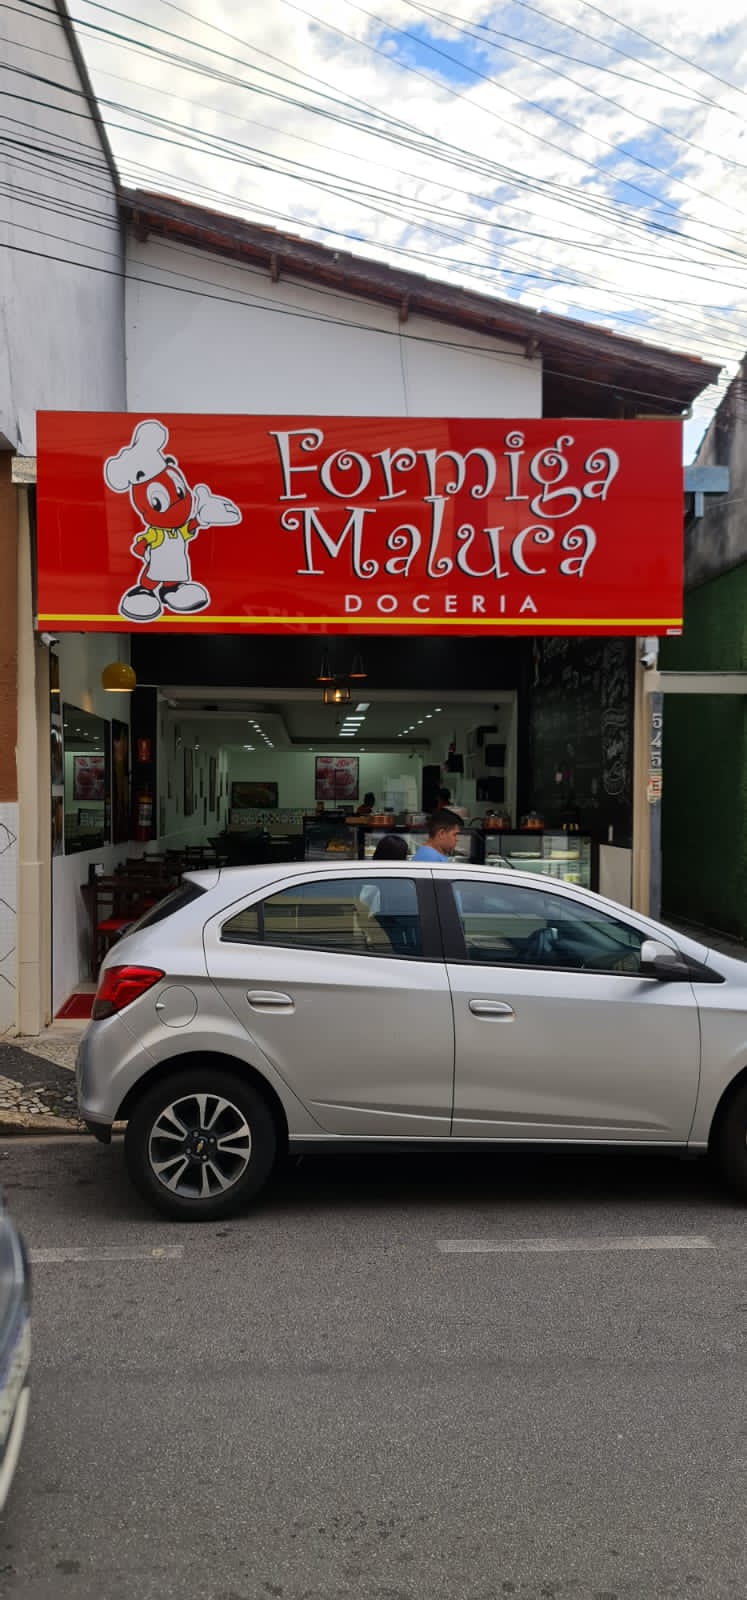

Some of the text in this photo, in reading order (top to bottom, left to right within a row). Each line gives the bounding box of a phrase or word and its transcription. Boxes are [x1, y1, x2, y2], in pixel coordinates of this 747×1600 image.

[269, 428, 621, 519] Formiga
[280, 497, 598, 580] Maluca
[344, 594, 538, 613] DOCERIA
